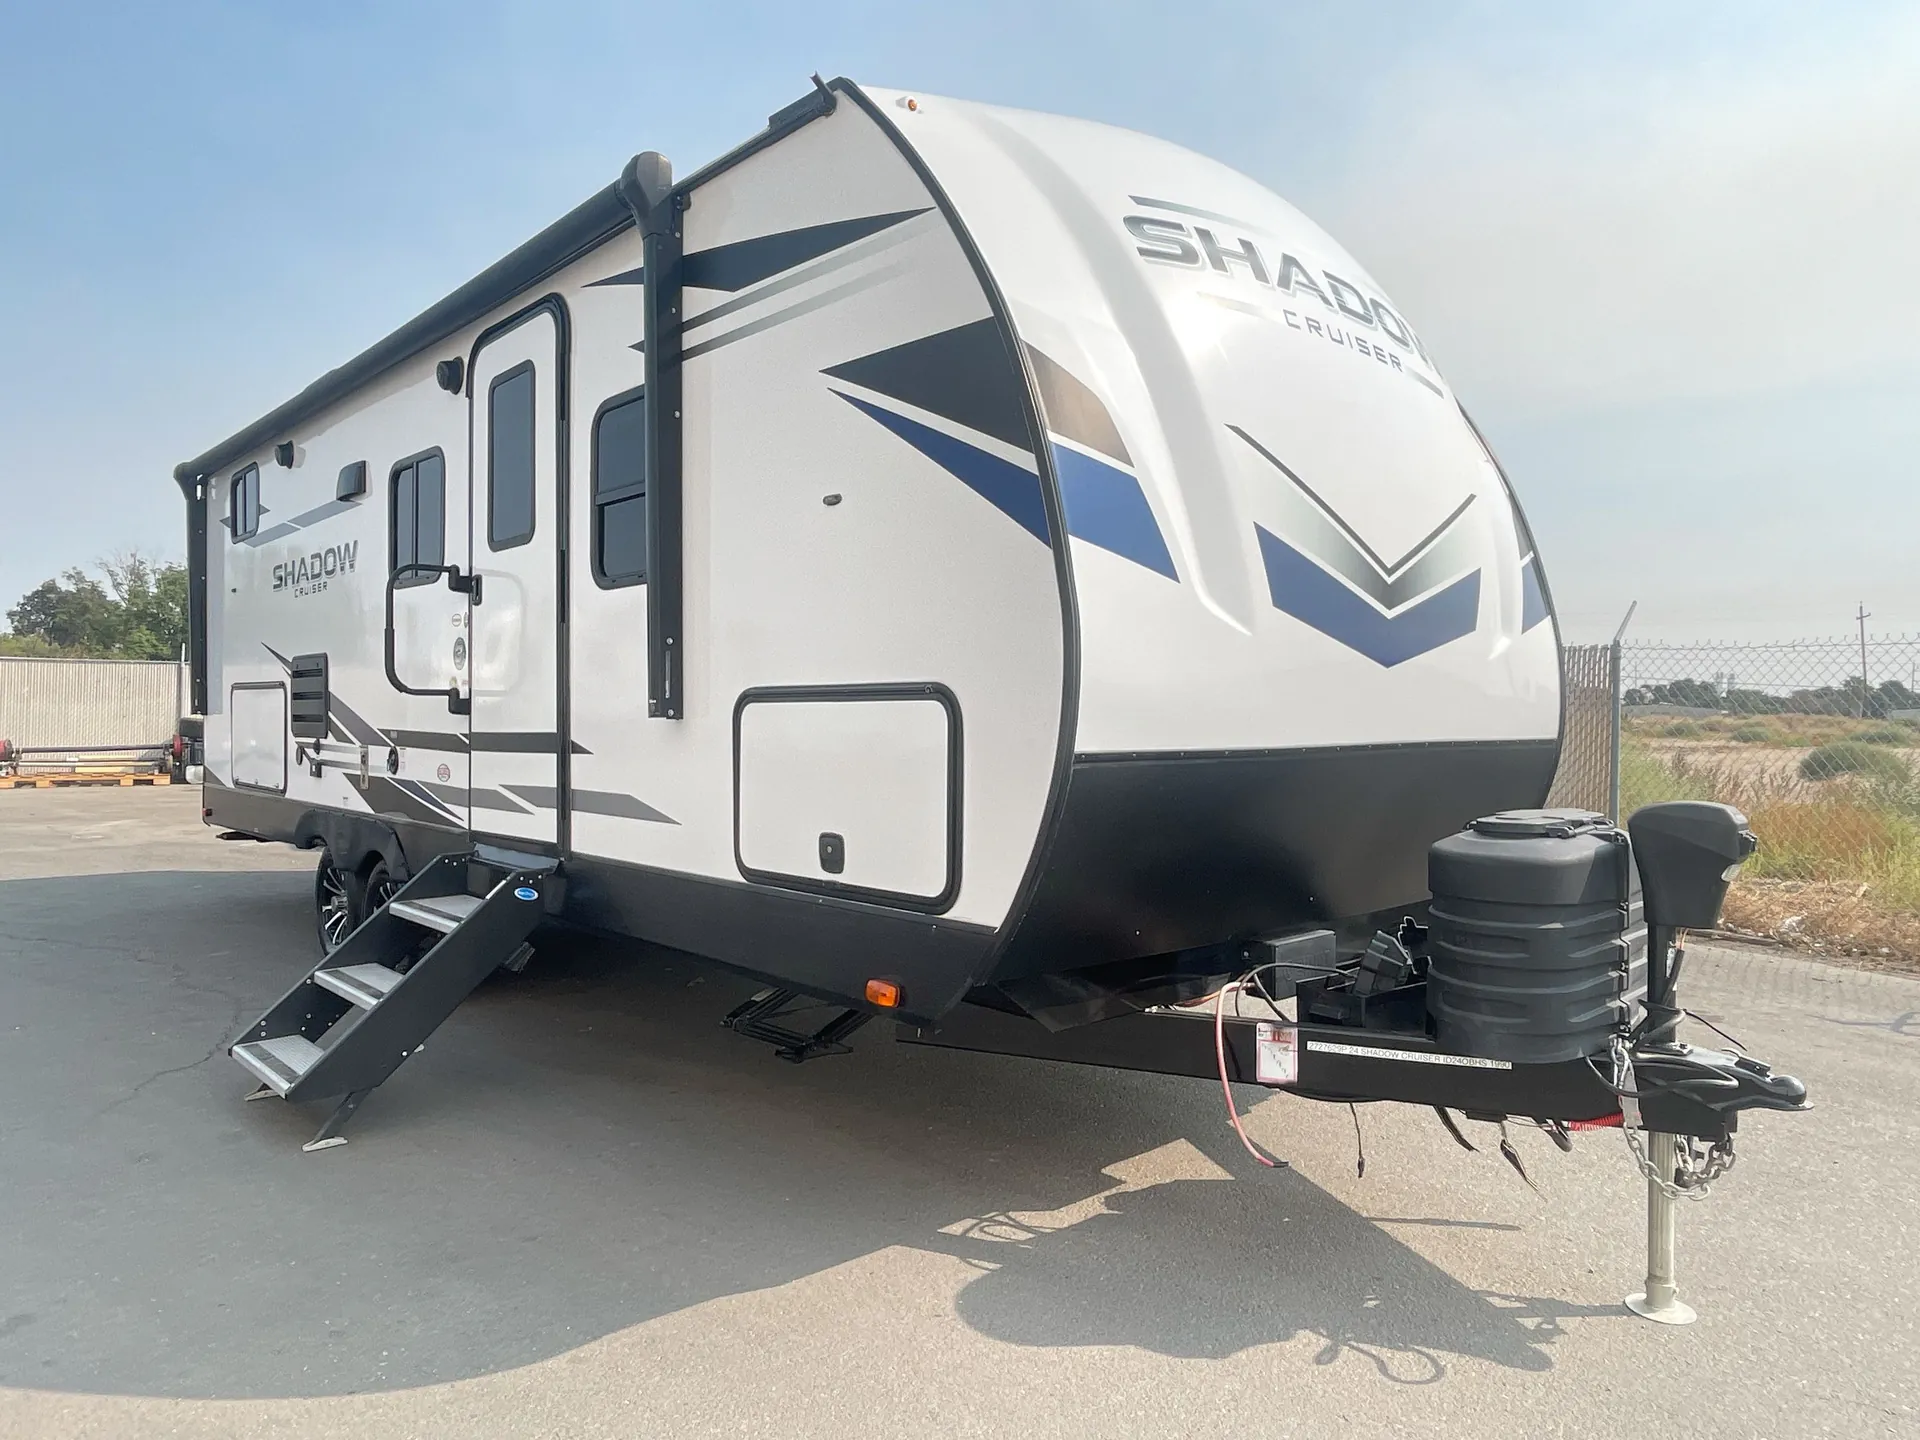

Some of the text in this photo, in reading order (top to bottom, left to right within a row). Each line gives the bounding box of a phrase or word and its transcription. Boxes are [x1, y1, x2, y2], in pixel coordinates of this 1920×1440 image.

[1282, 309, 1403, 373] CRUISER
[272, 540, 358, 592] SHADOW
[294, 581, 328, 598] CRUISER
[1349, 1046, 1359, 1055] 24
[1360, 1047, 1400, 1059] SHADOW
[1401, 1051, 1441, 1063] CRUISER
